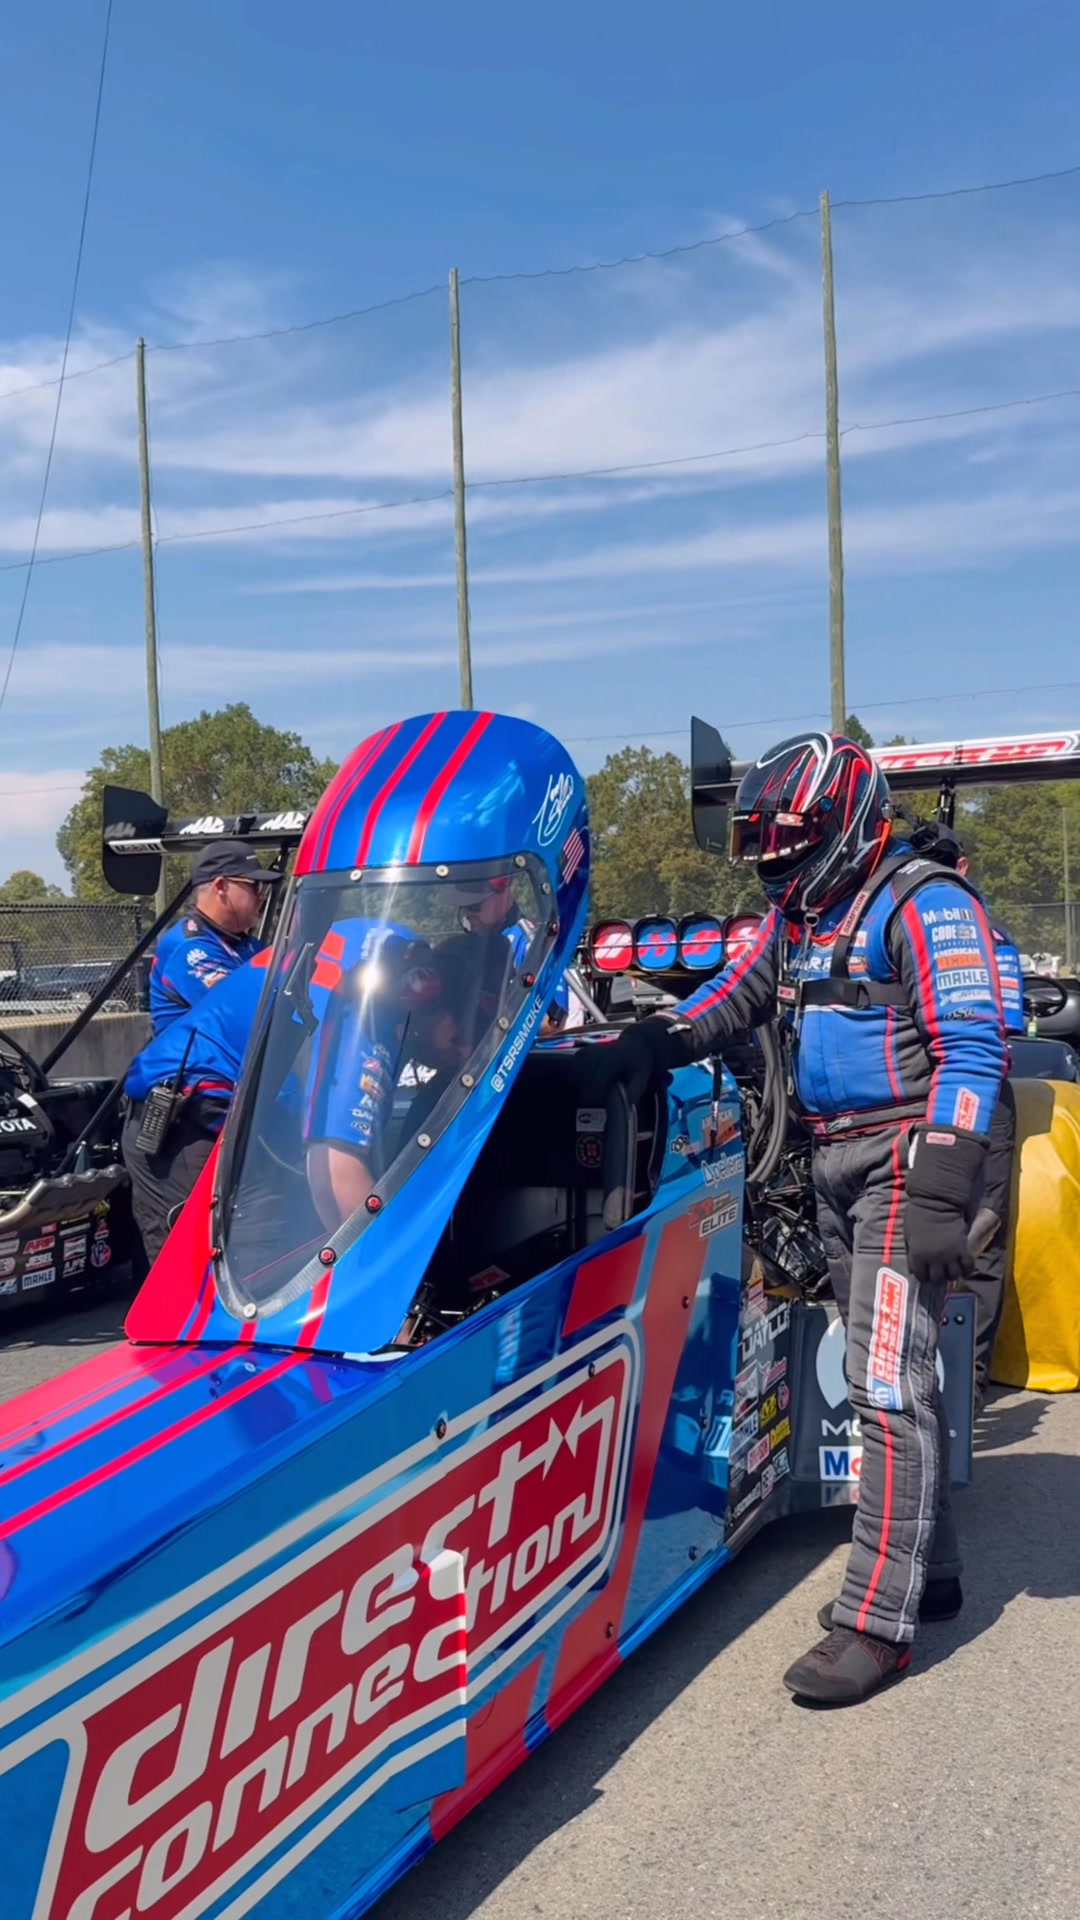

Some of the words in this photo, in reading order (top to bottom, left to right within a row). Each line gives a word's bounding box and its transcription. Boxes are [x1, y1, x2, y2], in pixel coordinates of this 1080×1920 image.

[843, 893, 867, 934] SIMPSON
[922, 908, 959, 926] Mobil
[931, 924, 956, 943] CODE
[938, 971, 987, 988] MAHLE
[491, 995, 545, 1093] @TSRSMOKE
[0, 1117, 37, 1133] OTA
[702, 1206, 737, 1235] ELITE
[23, 1270, 54, 1288] MAHLE
[85, 1416, 564, 1854] direct
